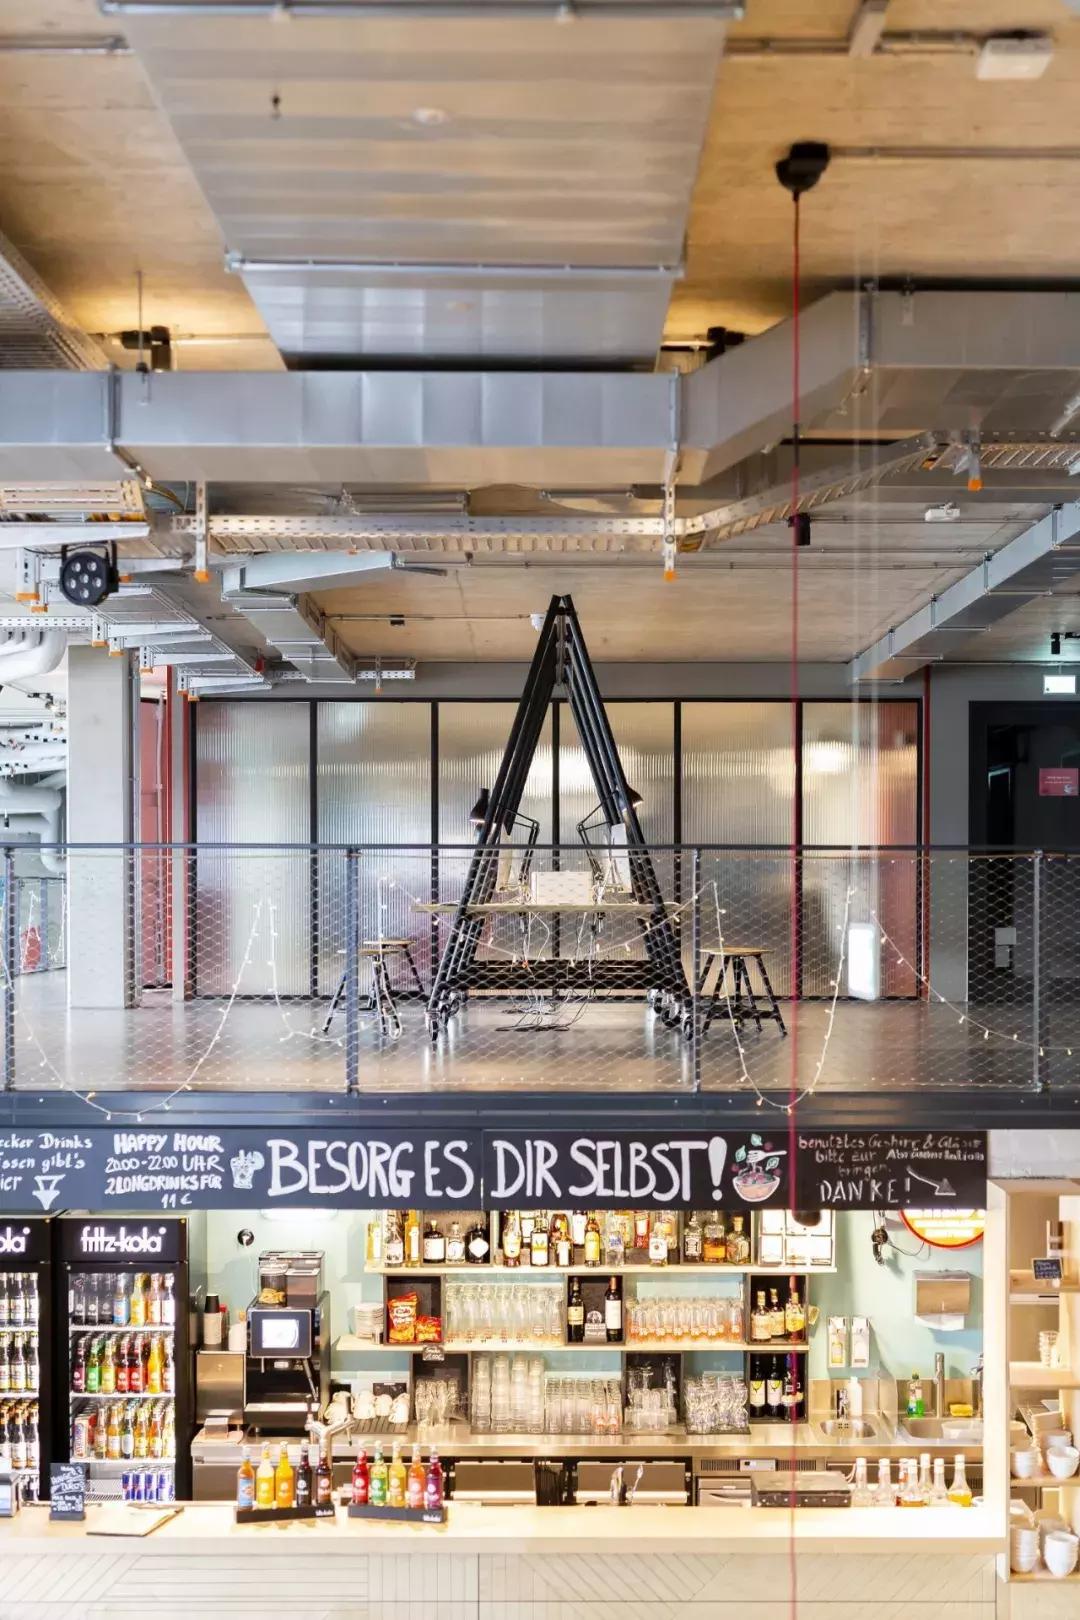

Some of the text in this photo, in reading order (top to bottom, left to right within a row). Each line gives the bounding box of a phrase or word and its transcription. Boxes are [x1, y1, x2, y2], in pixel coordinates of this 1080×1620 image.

[38, 1132, 93, 1149] Drinks
[113, 1132, 225, 1155] HAPPY HOUR
[0, 1151, 86, 1174] ssen gibt's
[182, 1154, 225, 1172] UHR
[815, 1149, 845, 1164] bitte
[851, 1151, 877, 1162] zur
[266, 1136, 728, 1202] BESORG ES DIR SELBST!
[161, 1193, 177, 1209] 11
[80, 1225, 163, 1253] fritz-kola
